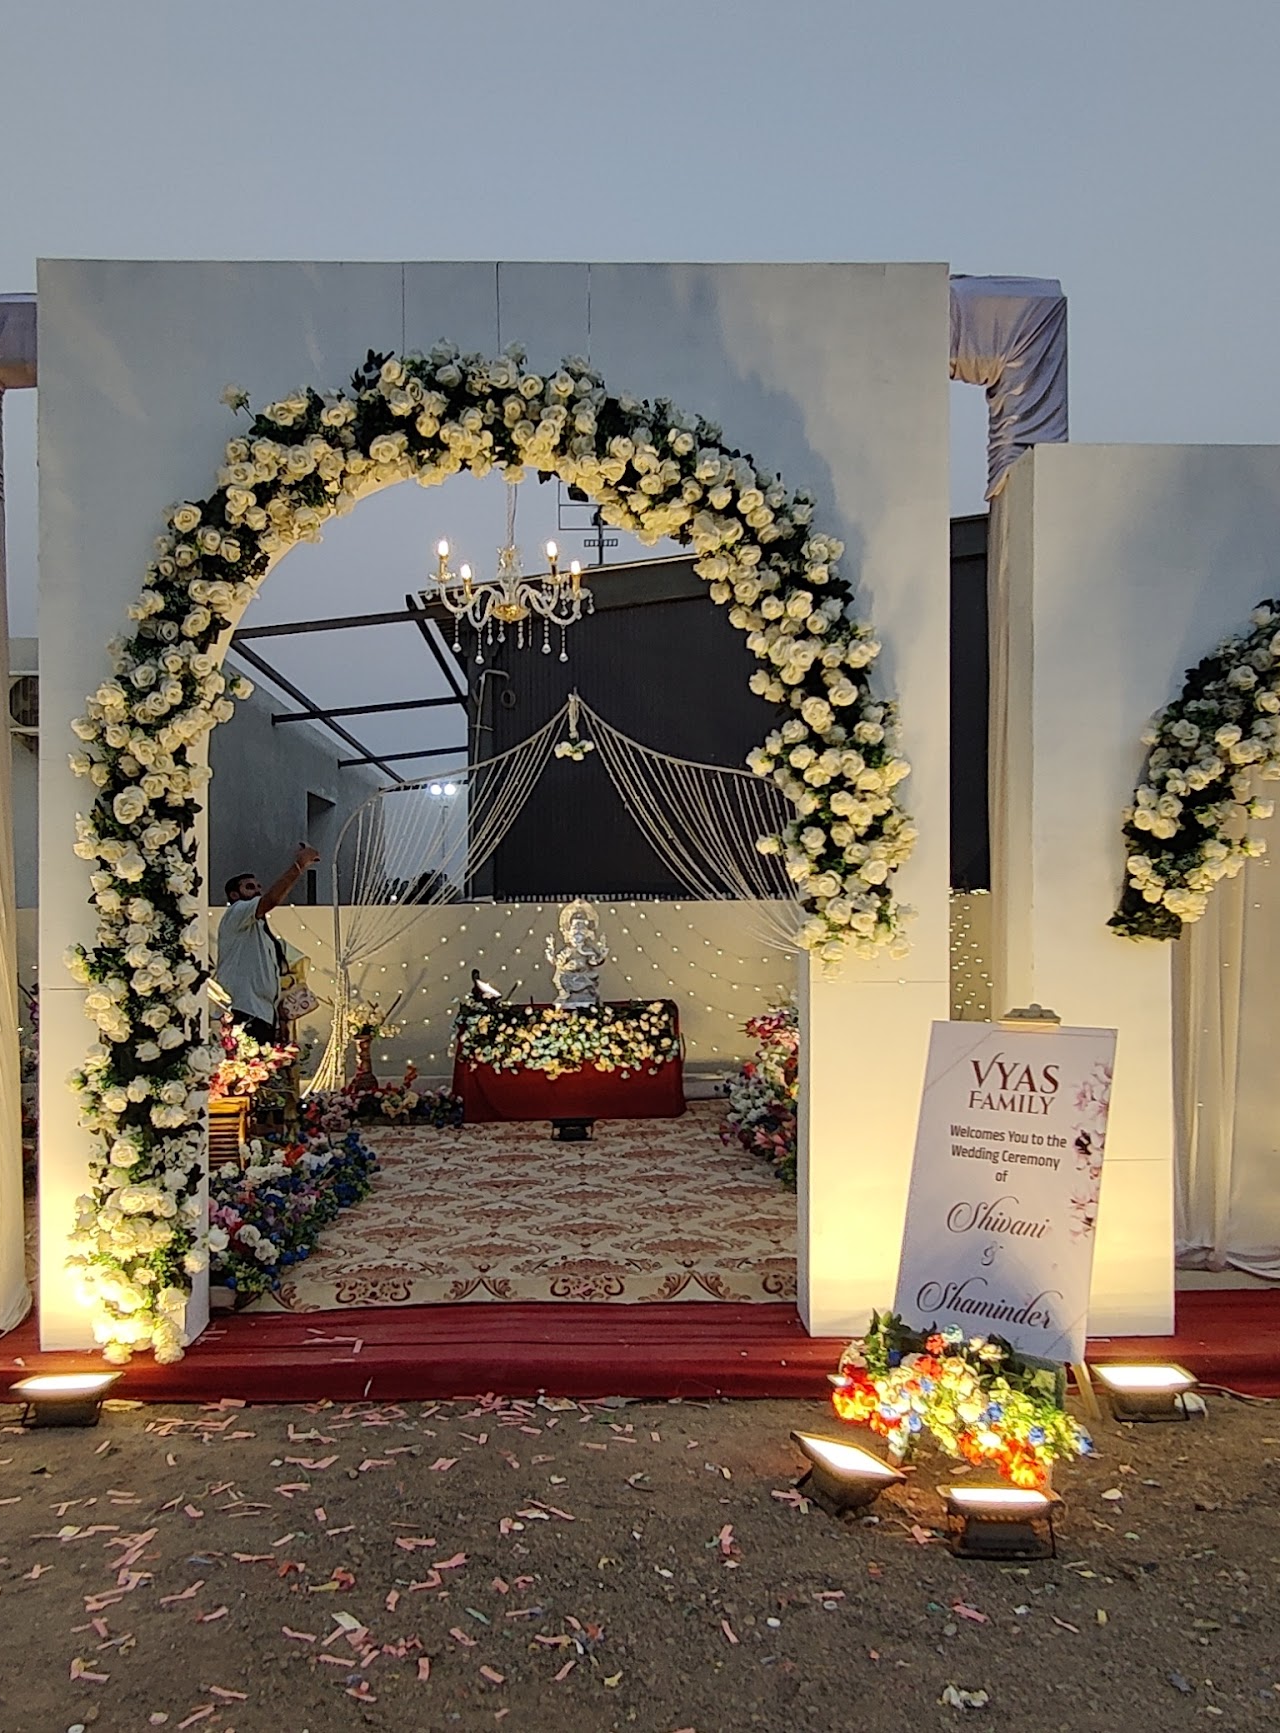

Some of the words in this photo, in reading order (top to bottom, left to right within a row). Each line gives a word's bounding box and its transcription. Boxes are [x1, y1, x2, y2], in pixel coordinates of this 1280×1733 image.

[969, 1052, 1060, 1095] VYAS
[968, 1090, 1056, 1115] FAMILY
[950, 1124, 1005, 1142] Welcomes
[1008, 1129, 1029, 1145] You
[1031, 1133, 1044, 1146] to
[1047, 1134, 1067, 1149] the
[951, 1144, 999, 1164] Wedding
[1001, 1150, 1060, 1171] Ceremony
[995, 1169, 1008, 1183] of
[947, 1196, 1050, 1239] Shivani
[916, 1276, 1064, 1330] Shaminder
